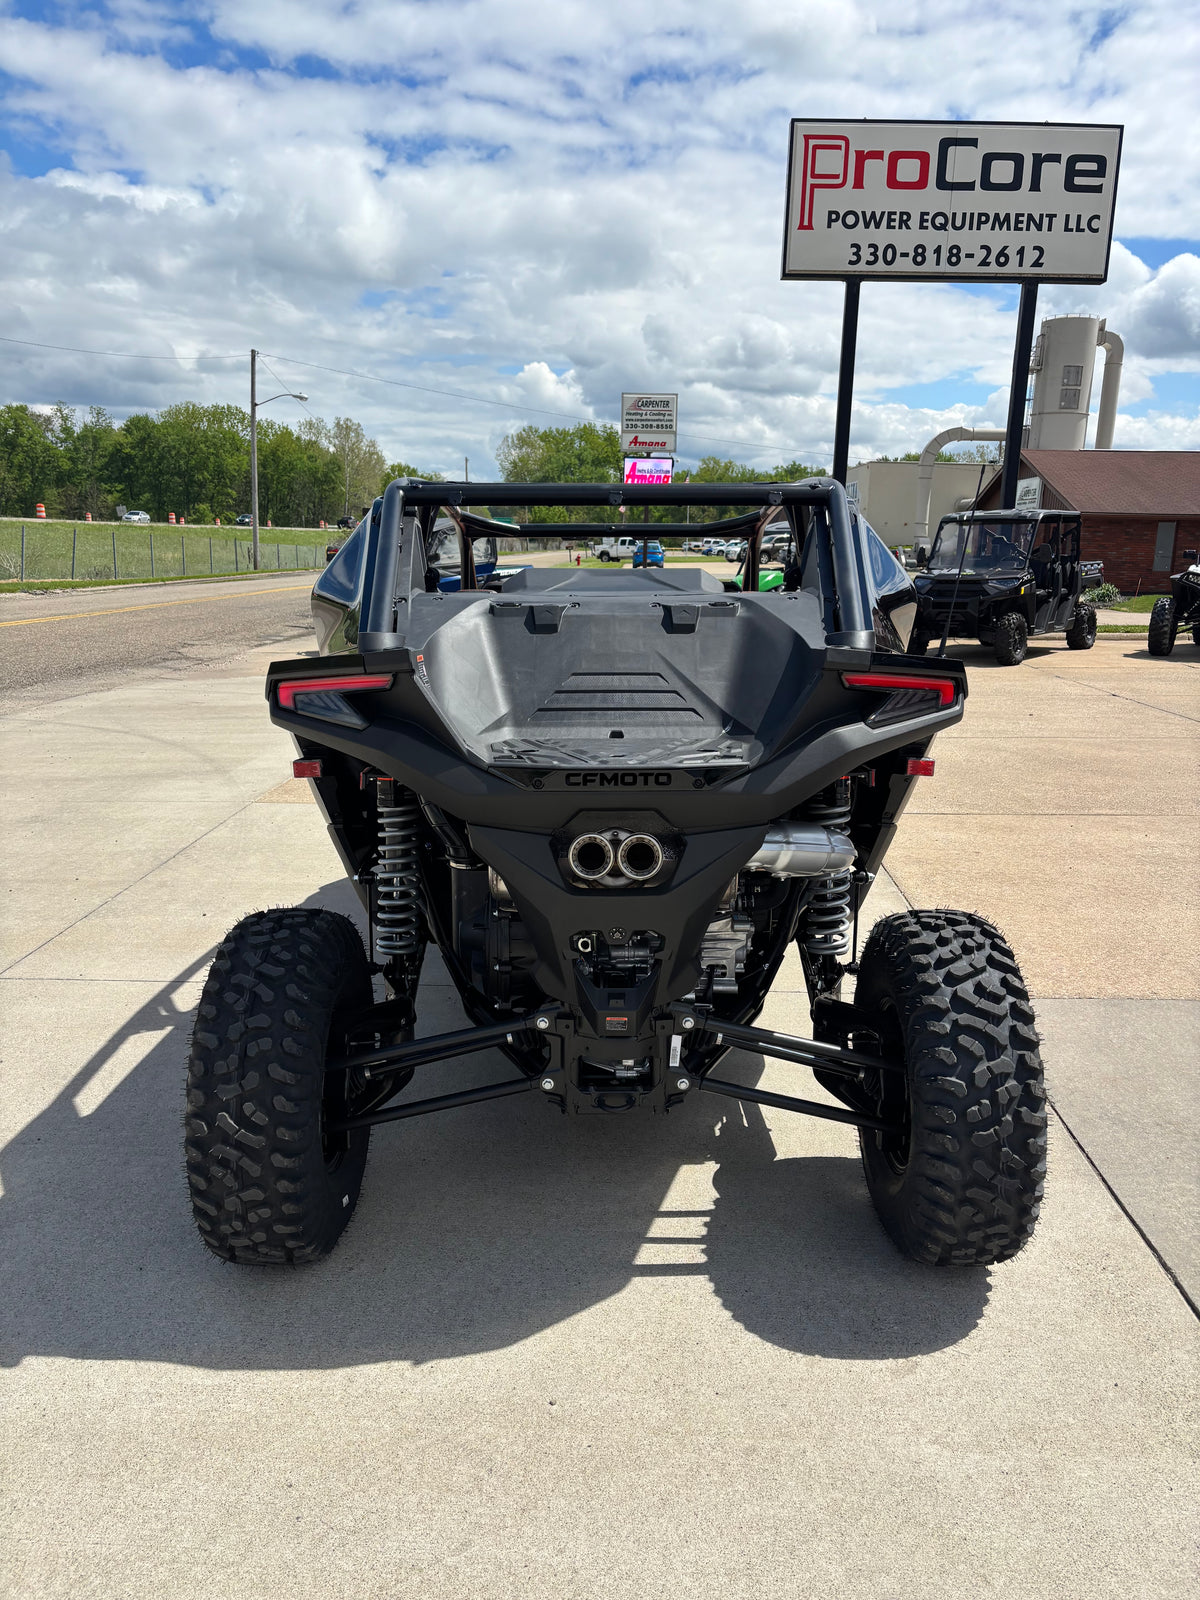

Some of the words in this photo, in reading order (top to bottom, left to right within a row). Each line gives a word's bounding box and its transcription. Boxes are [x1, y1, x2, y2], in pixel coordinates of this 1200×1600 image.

[797, 134, 1108, 230] ProCore
[826, 210, 912, 230] POWER
[918, 211, 1058, 233] EQUIPMENT
[1063, 213, 1101, 234] LLC
[847, 243, 1045, 268] 330-818-2612
[637, 400, 670, 408] CARPENTER
[628, 435, 667, 447] Amana
[625, 462, 671, 484] Amana
[565, 772, 672, 786] CFMOTO
